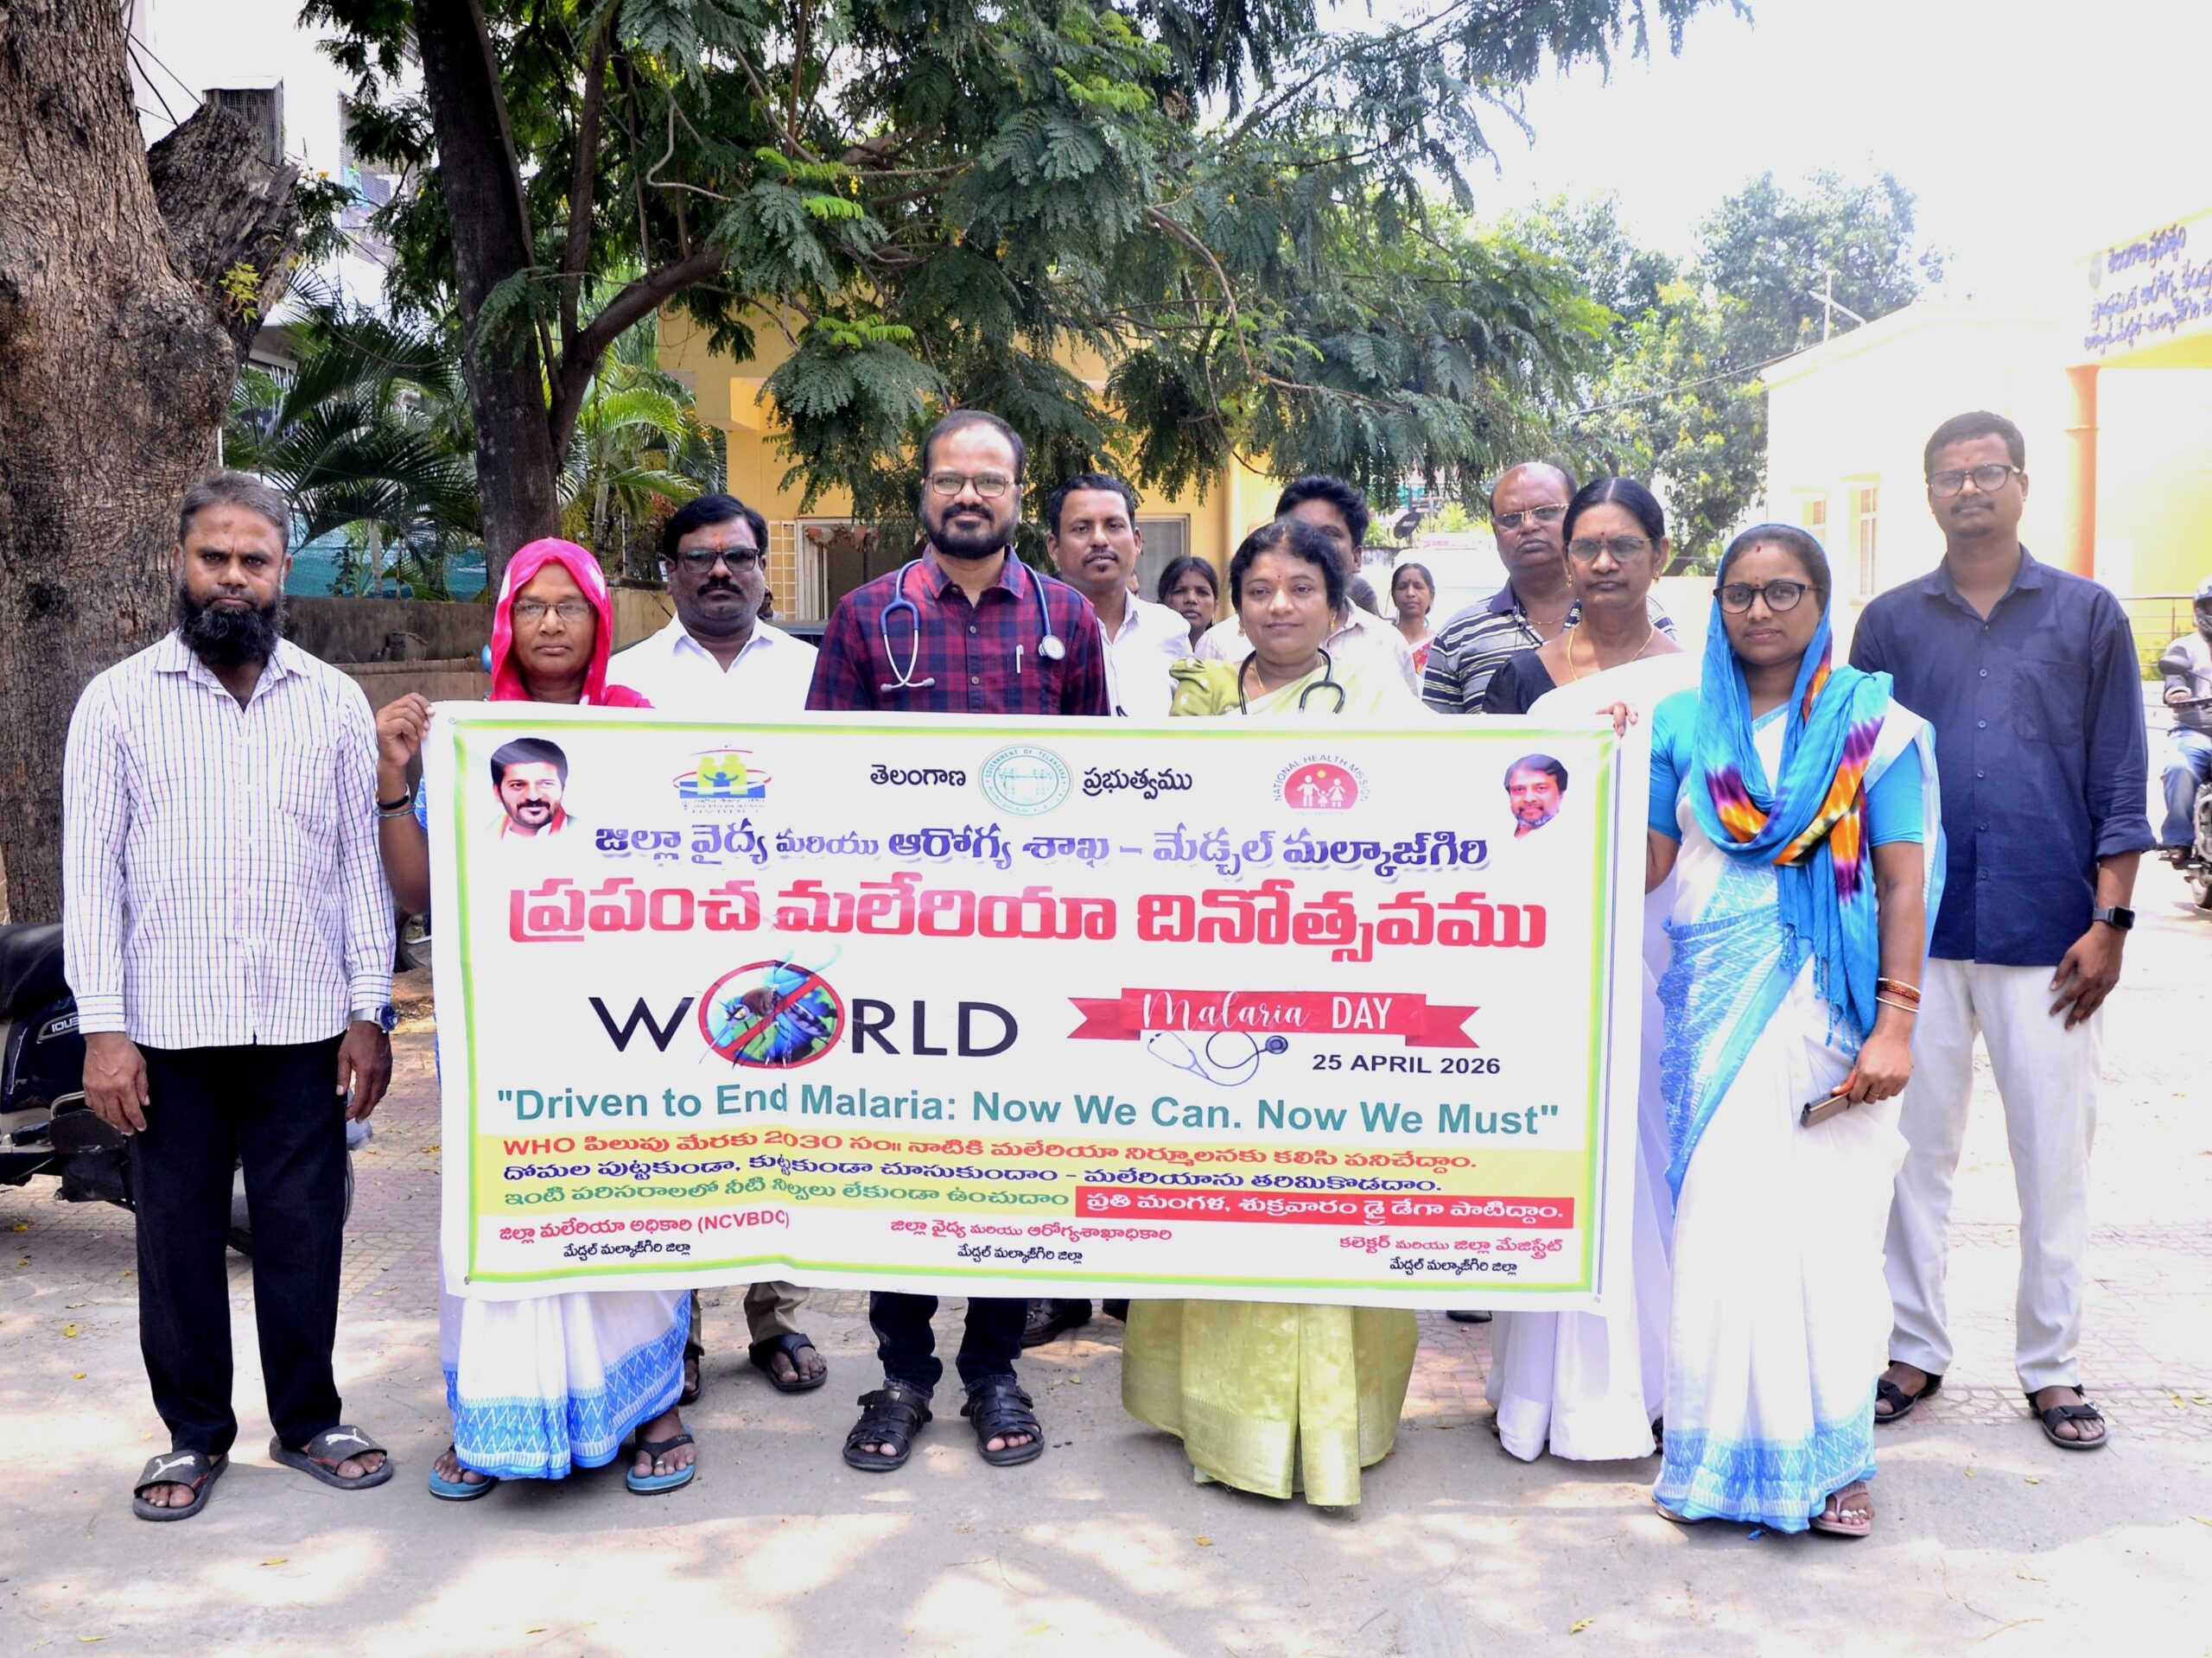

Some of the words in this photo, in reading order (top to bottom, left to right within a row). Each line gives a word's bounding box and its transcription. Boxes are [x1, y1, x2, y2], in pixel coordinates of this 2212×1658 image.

[870, 764, 966, 786] తెలంగాణ
[1082, 767, 1193, 798] ప్రభుత్వము
[1273, 760, 1301, 801] NATIONAL
[1303, 754, 1348, 766] HEALTH
[595, 827, 682, 860] జిల్లా
[690, 817, 768, 865] వైద్య
[775, 829, 880, 855] మరియు
[888, 822, 1012, 870] ఆరోగ్య
[1022, 832, 1109, 868] శాఖ
[1153, 822, 1276, 876] మేడ్చల్
[509, 876, 760, 943] ప్రపంచ
[773, 872, 1116, 940] మలేరియా
[1137, 879, 1547, 962] దినోత్సవము
[1141, 990, 1310, 1031] Malaria
[1332, 996, 1393, 1030] DAY
[1313, 1054, 1343, 1070] 25
[1350, 1055, 1433, 1073] APRIL
[1440, 1057, 1500, 1075] 2026
[498, 1089, 648, 1121] "Driven
[663, 1089, 702, 1117] to
[717, 1083, 787, 1115] End
[801, 1085, 956, 1121] Malaria:
[973, 1092, 1061, 1122] Now
[1074, 1095, 1137, 1126] We
[1151, 1097, 1242, 1130] Can.
[1258, 1100, 1348, 1130] Now
[1360, 1102, 1424, 1134] We
[1438, 1104, 1559, 1135] Must"
[504, 1138, 575, 1156] WHO
[584, 1135, 670, 1153] పిలుపు
[677, 1133, 758, 1151] మేరకు
[764, 1131, 842, 1147] 2030
[907, 1139, 984, 1155] నాటికి
[991, 1140, 1119, 1159] మలేరియా
[1125, 1147, 1268, 1166] నిర్మూలనకు
[1274, 1150, 1338, 1166] కలిసి
[504, 1164, 591, 1180] దోమల
[749, 1153, 874, 1176] కుట్టకుండా
[880, 1162, 1058, 1180] చూసుకుందాం
[1084, 1167, 1244, 1187] మలేరియాను
[505, 1186, 565, 1205] ఇంటి
[571, 1180, 719, 1201] పరిసరాలలో
[725, 1176, 766, 1195] నీటి
[772, 1178, 836, 1201] నిల్వలు
[842, 1181, 940, 1201] లేకుండా
[947, 1186, 1070, 1205] ఉంచుదాం
[1086, 1191, 1132, 1211] ప్రతి
[1238, 1196, 1358, 1217] శుక్రవారం
[1390, 1198, 1445, 1217] డేగా
[499, 1225, 536, 1244] జిల్లా
[540, 1217, 626, 1238] మలేరియా
[630, 1218, 692, 1235] అధికారి
[697, 1210, 791, 1234] (NCVBDC)
[890, 1219, 928, 1236] జిల్లా
[931, 1219, 967, 1237] వైద్య
[969, 1223, 1023, 1236] మరియు
[1339, 1236, 1391, 1255] కలెక్టర్
[1395, 1240, 1450, 1250] మరియు
[1453, 1239, 1491, 1255] జిల్లా
